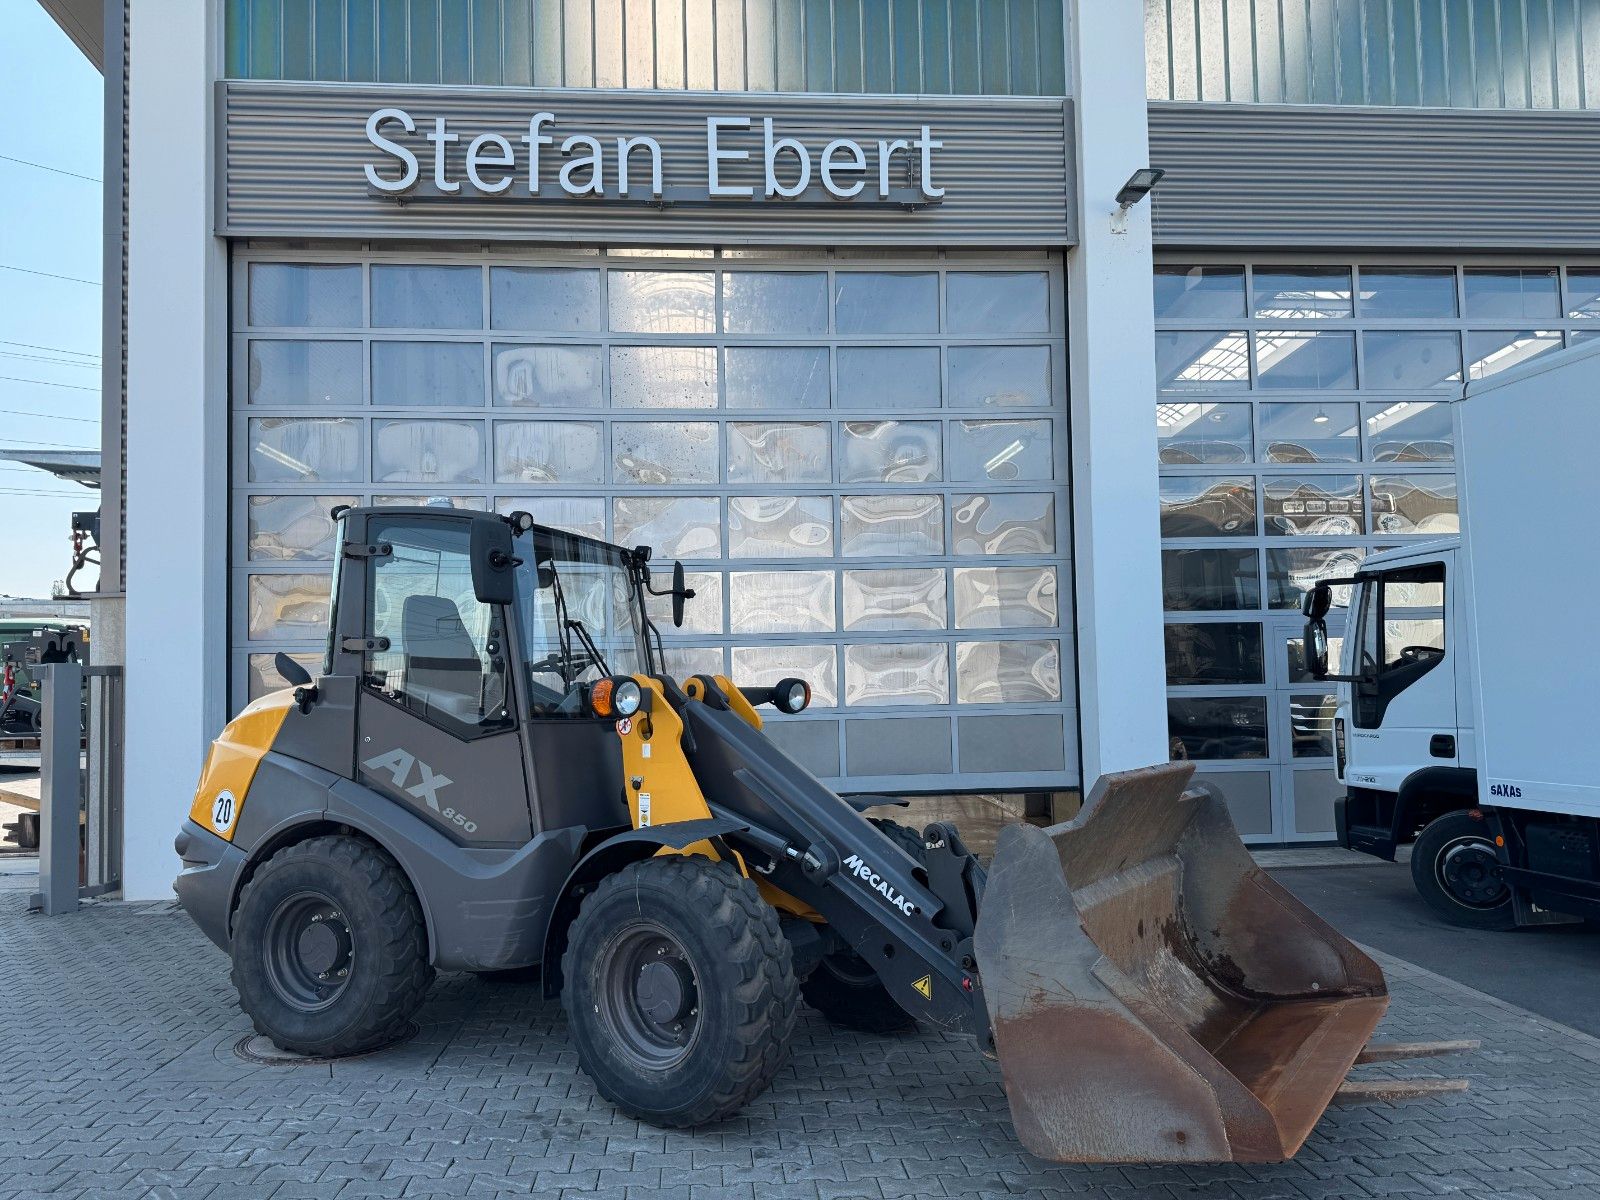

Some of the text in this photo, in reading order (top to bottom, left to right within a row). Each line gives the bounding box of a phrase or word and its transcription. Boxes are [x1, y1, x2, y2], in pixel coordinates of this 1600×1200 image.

[364, 108, 945, 197] Stefan Ebert
[362, 747, 454, 813] AX
[1490, 783, 1522, 798] SAXAS
[215, 797, 232, 824] 20
[442, 807, 478, 833] 850
